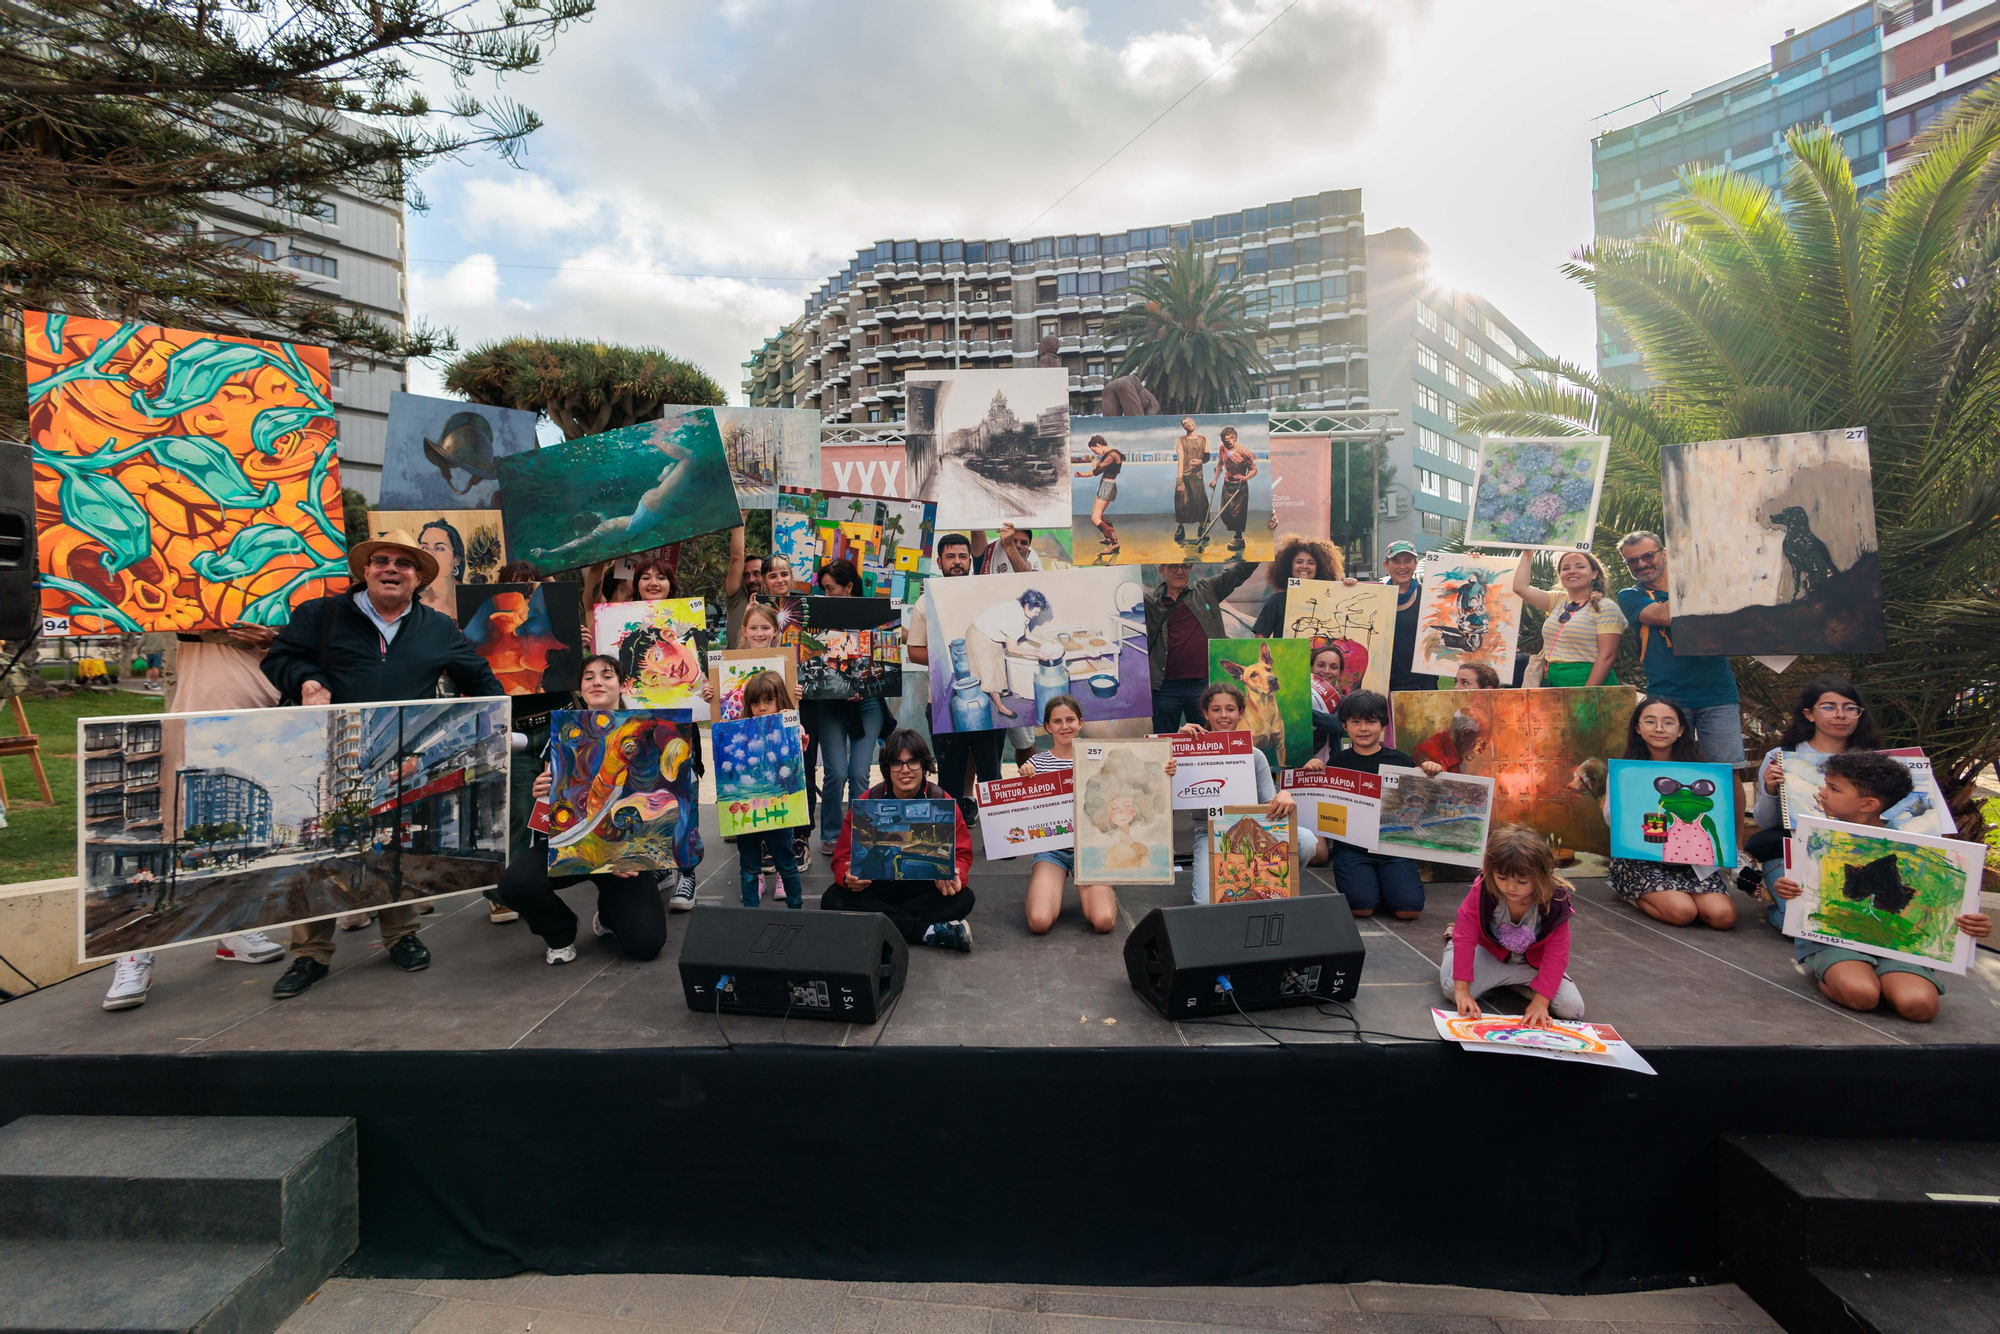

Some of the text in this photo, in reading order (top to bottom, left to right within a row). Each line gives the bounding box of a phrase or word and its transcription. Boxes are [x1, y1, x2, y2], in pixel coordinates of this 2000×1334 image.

[1846, 430, 1864, 439] 27
[45, 620, 69, 630] 94
[1197, 742, 1224, 751] RÁPIDA
[1331, 776, 1355, 788] RÁPIDA
[995, 782, 1056, 800] PINTURA RÁPIDA
[1184, 787, 1220, 795] PECAN
[1033, 801, 1060, 810] CATEGORÍA
[1209, 807, 1223, 816] 81
[1027, 819, 1072, 829] JUGUETERIAS
[1028, 822, 1074, 839] Nikki
[1332, 970, 1346, 994] JSA
[694, 985, 704, 993] 11
[841, 987, 854, 1010] JSA
[1187, 997, 1197, 1008] 10
